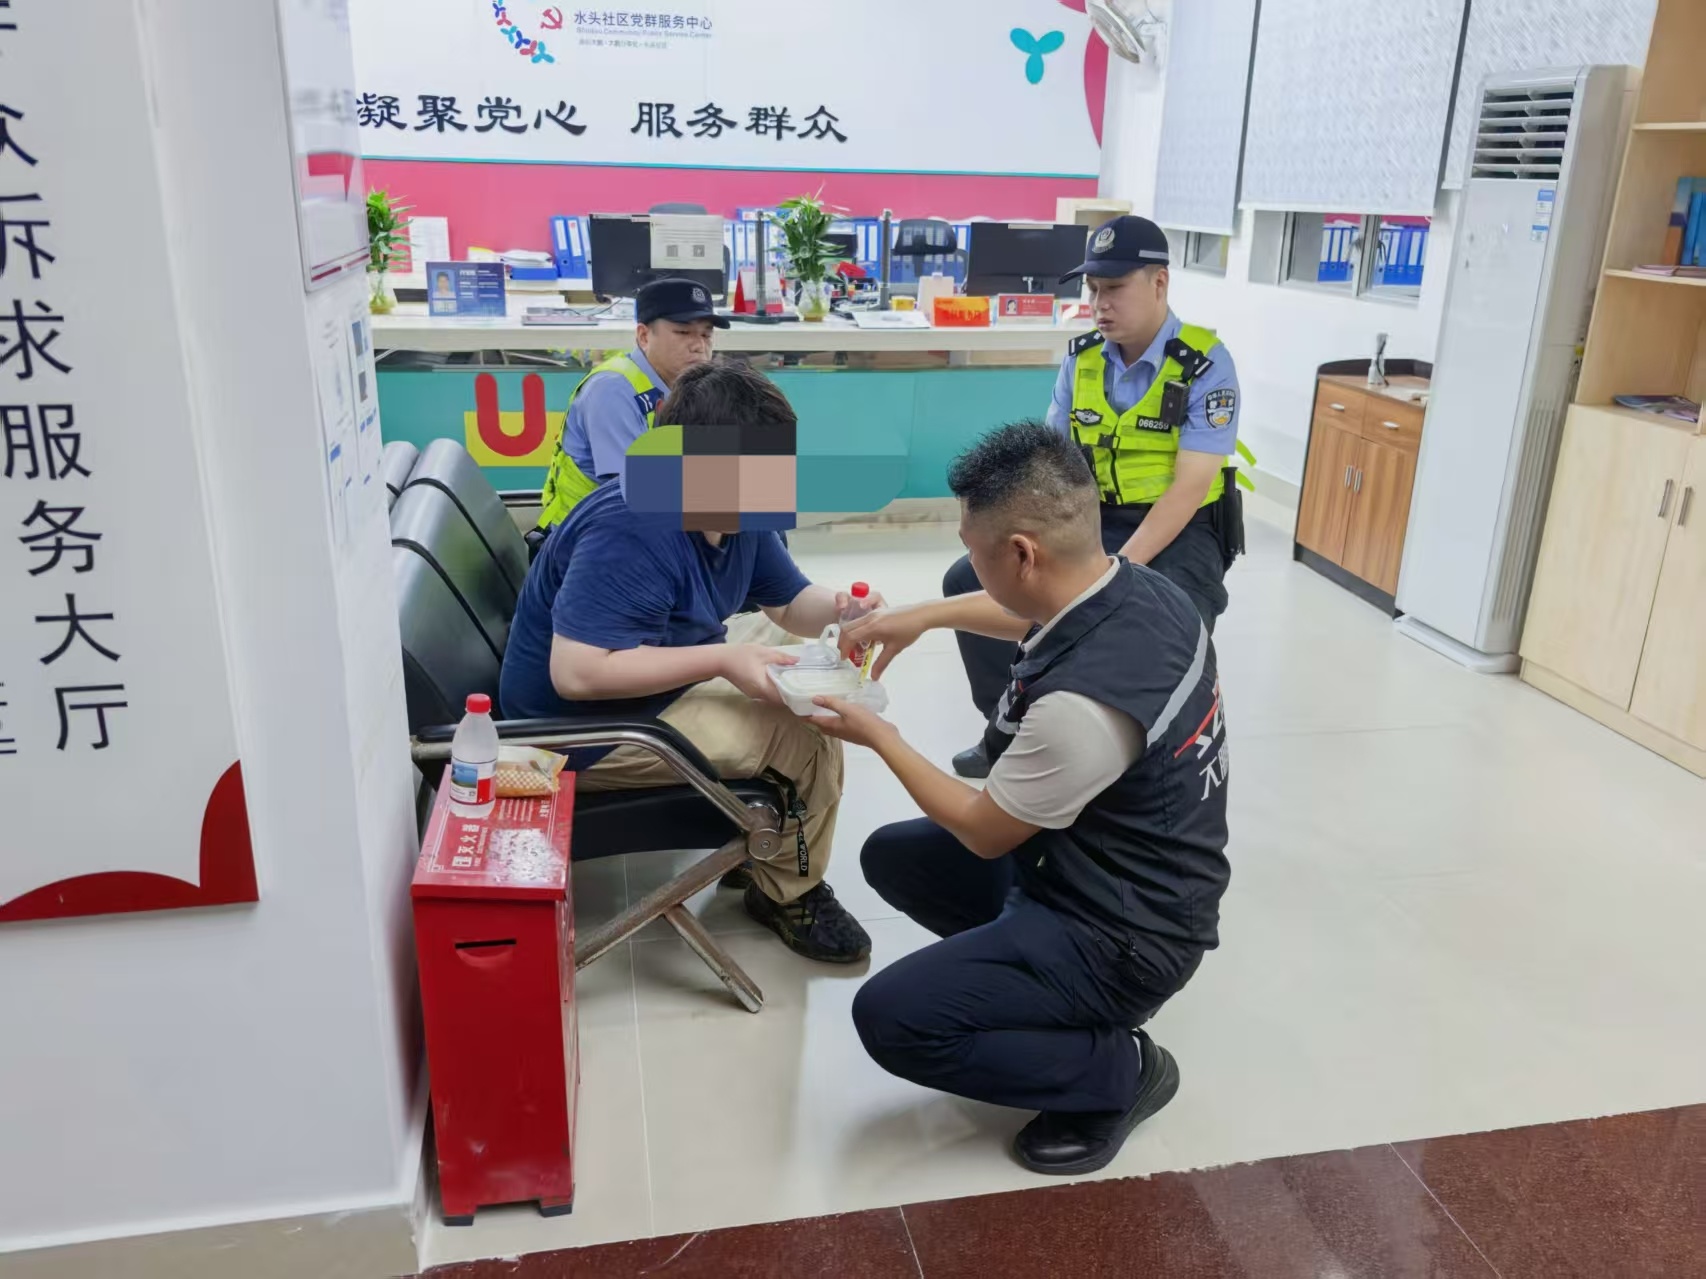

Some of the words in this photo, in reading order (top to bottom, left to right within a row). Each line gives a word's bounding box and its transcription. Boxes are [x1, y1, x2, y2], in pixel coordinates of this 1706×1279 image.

[574, 11, 713, 30] 水头社区党群服务中心
[356, 92, 587, 136] 凝聚党心
[630, 102, 848, 143] 服务群众
